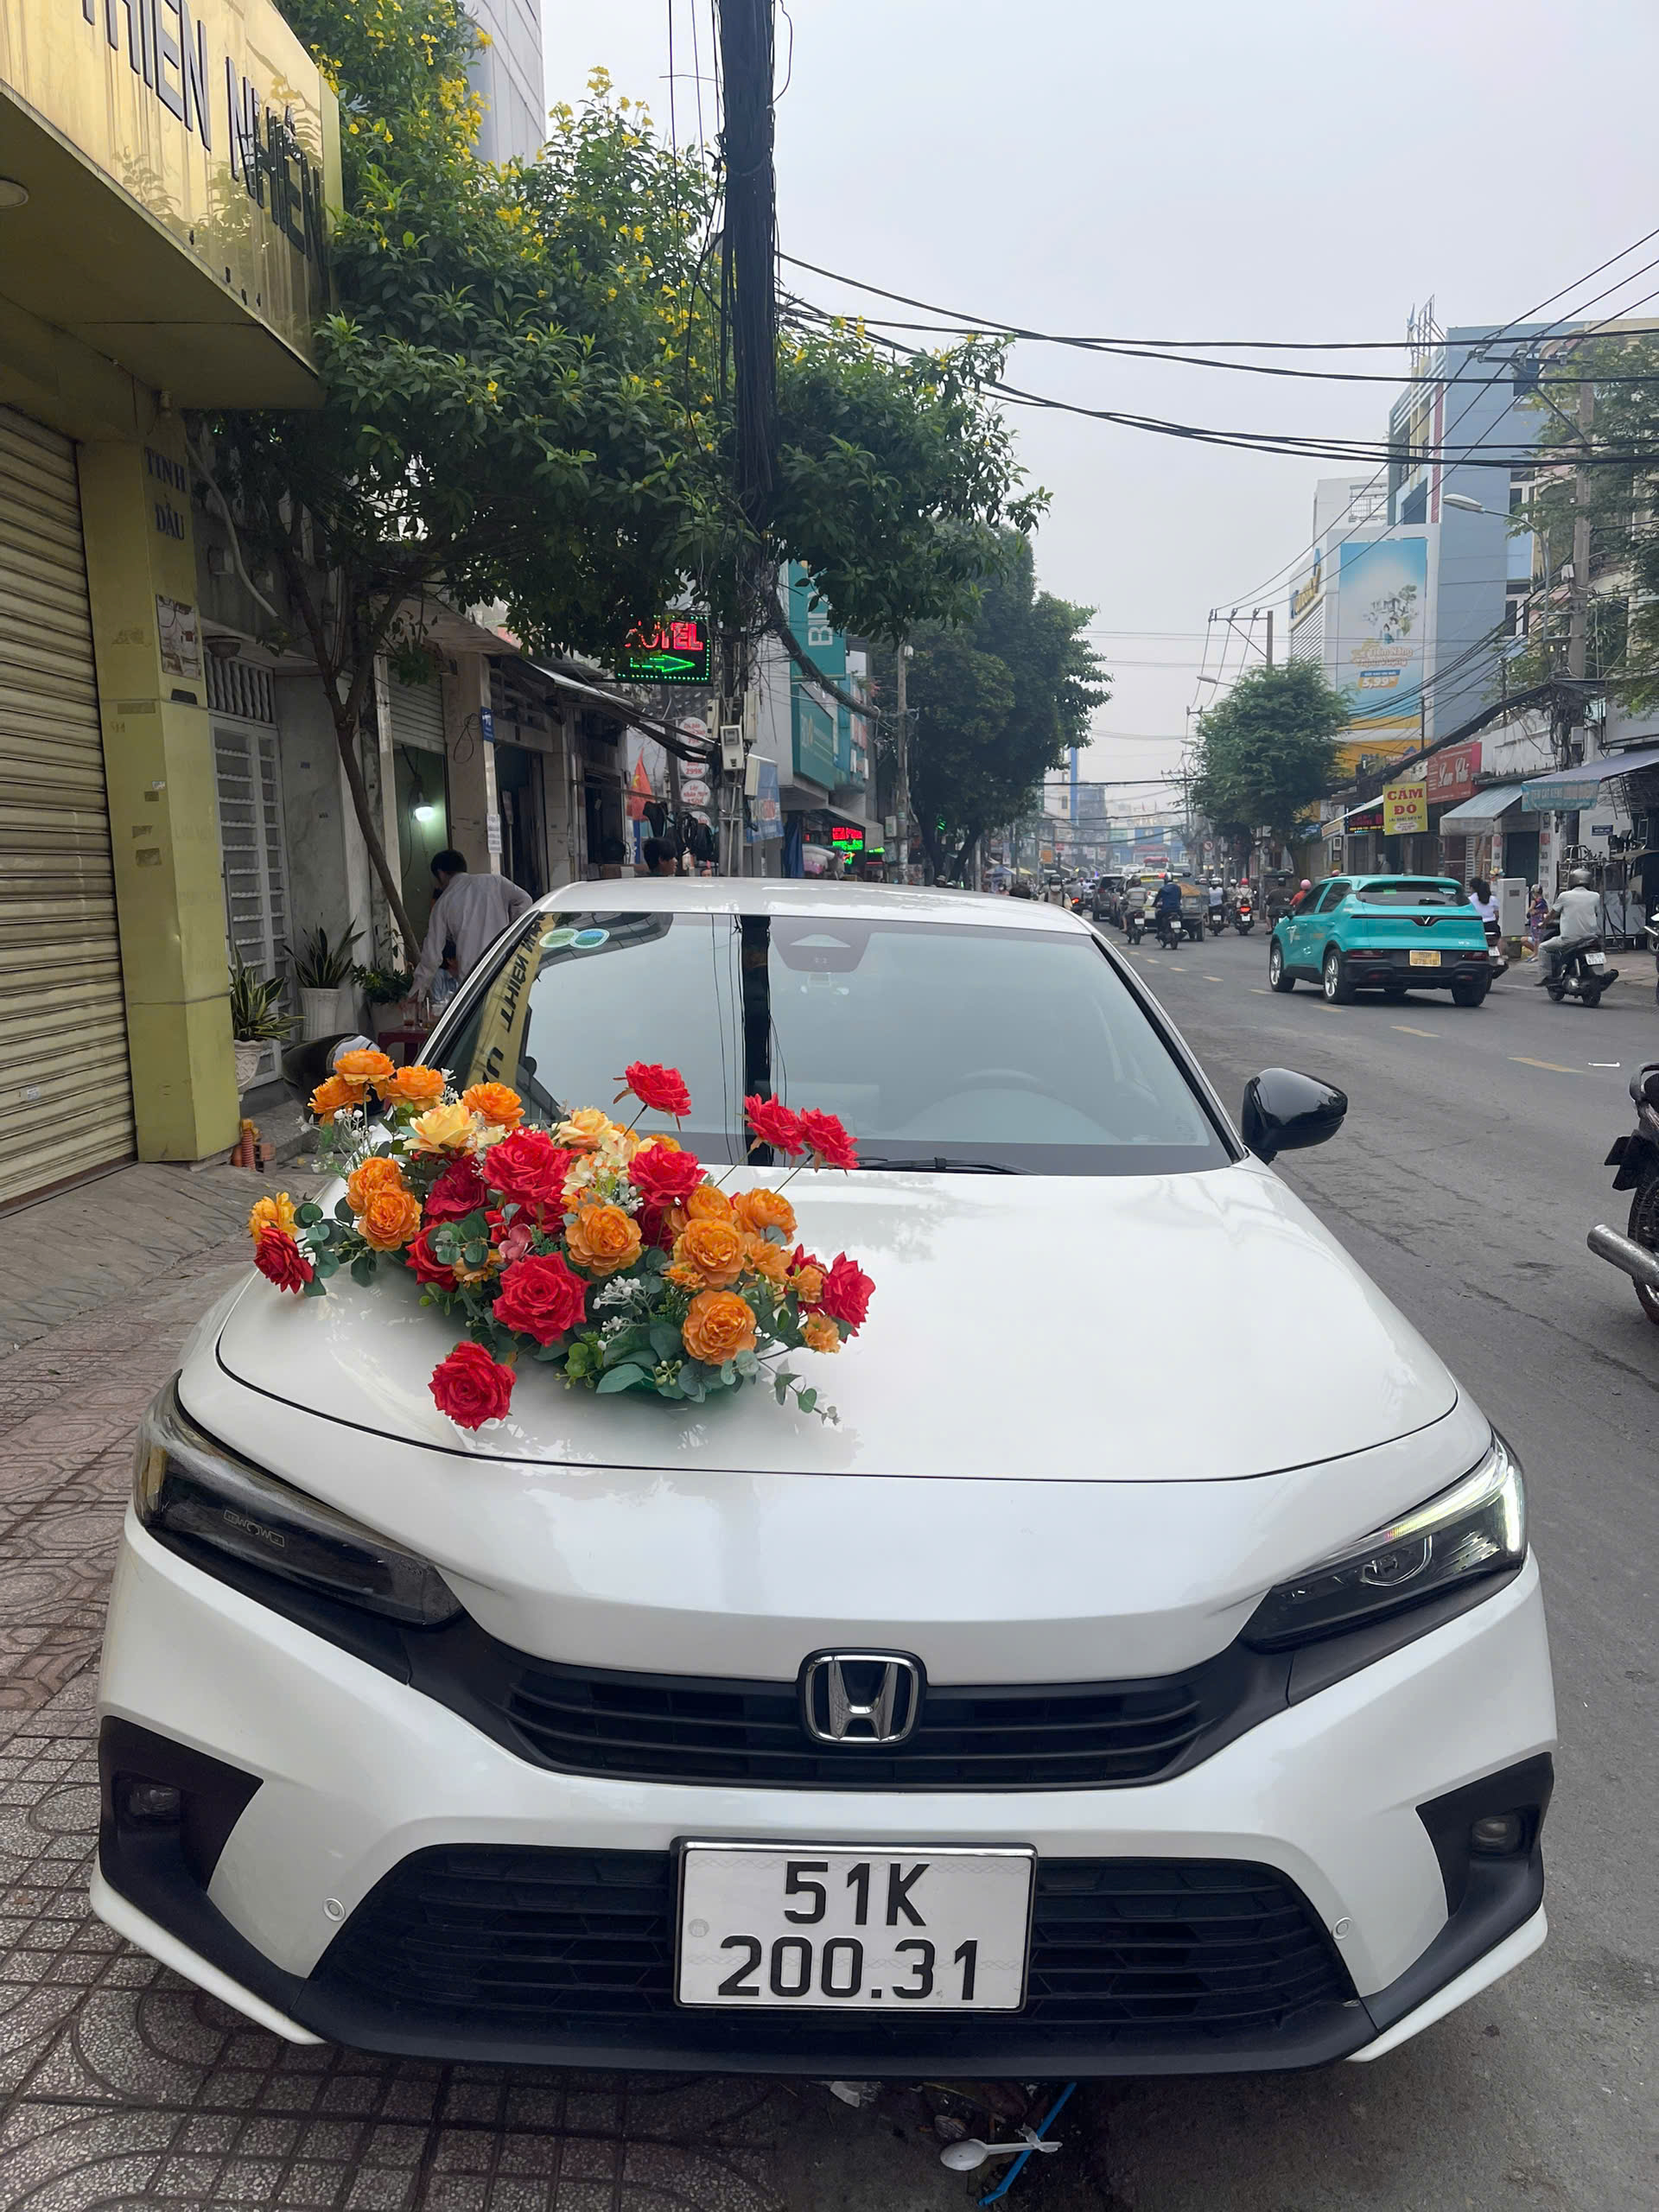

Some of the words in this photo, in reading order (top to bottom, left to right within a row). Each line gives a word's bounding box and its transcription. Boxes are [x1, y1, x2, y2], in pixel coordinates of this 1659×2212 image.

[145, 446, 186, 493] TINH
[784, 1860, 931, 1927] 51K
[718, 1935, 978, 2001] 200.31
